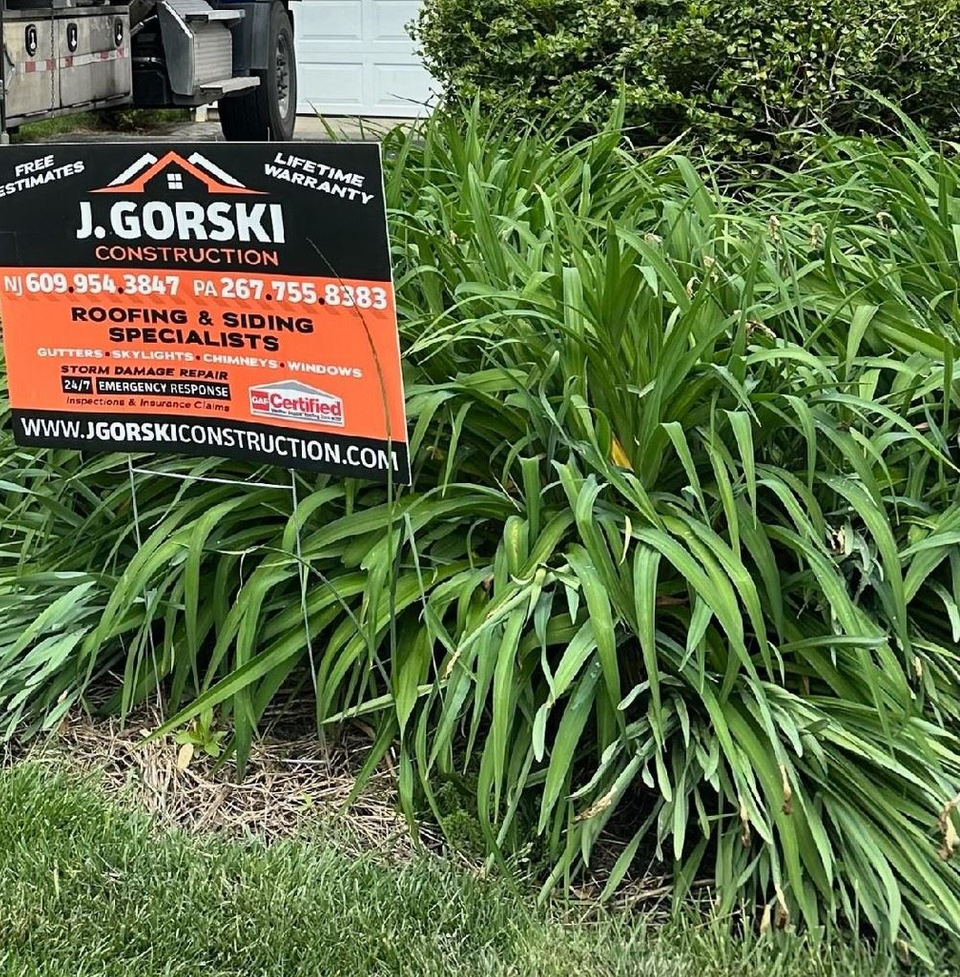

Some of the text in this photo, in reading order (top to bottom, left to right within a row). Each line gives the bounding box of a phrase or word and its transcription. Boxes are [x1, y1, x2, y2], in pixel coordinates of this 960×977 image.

[15, 154, 55, 177] FREE
[274, 152, 365, 187] LIFETIME
[264, 163, 374, 205] WARRANTY
[76, 201, 286, 243] J.GORSKI
[95, 245, 279, 266] CONSTRUCTION
[4, 274, 388, 310] NJ 609.954.3847 PA 267.755.8383
[71, 307, 315, 333] ROOFING & SIDING
[109, 327, 279, 351] SPECIALISTS
[37, 347, 103, 359] GUTTERS
[287, 361, 363, 378] WINDOWS
[60, 364, 229, 381] STORM DAMAGE REPAIR
[64, 378, 229, 398] 24/7 EMERGENCY RESPONSE
[66, 396, 230, 412] Inspections & Insurance Claims
[269, 393, 342, 417] Certified
[20, 417, 399, 471] WWW.JGORSKICONSTRUCTION.COM
